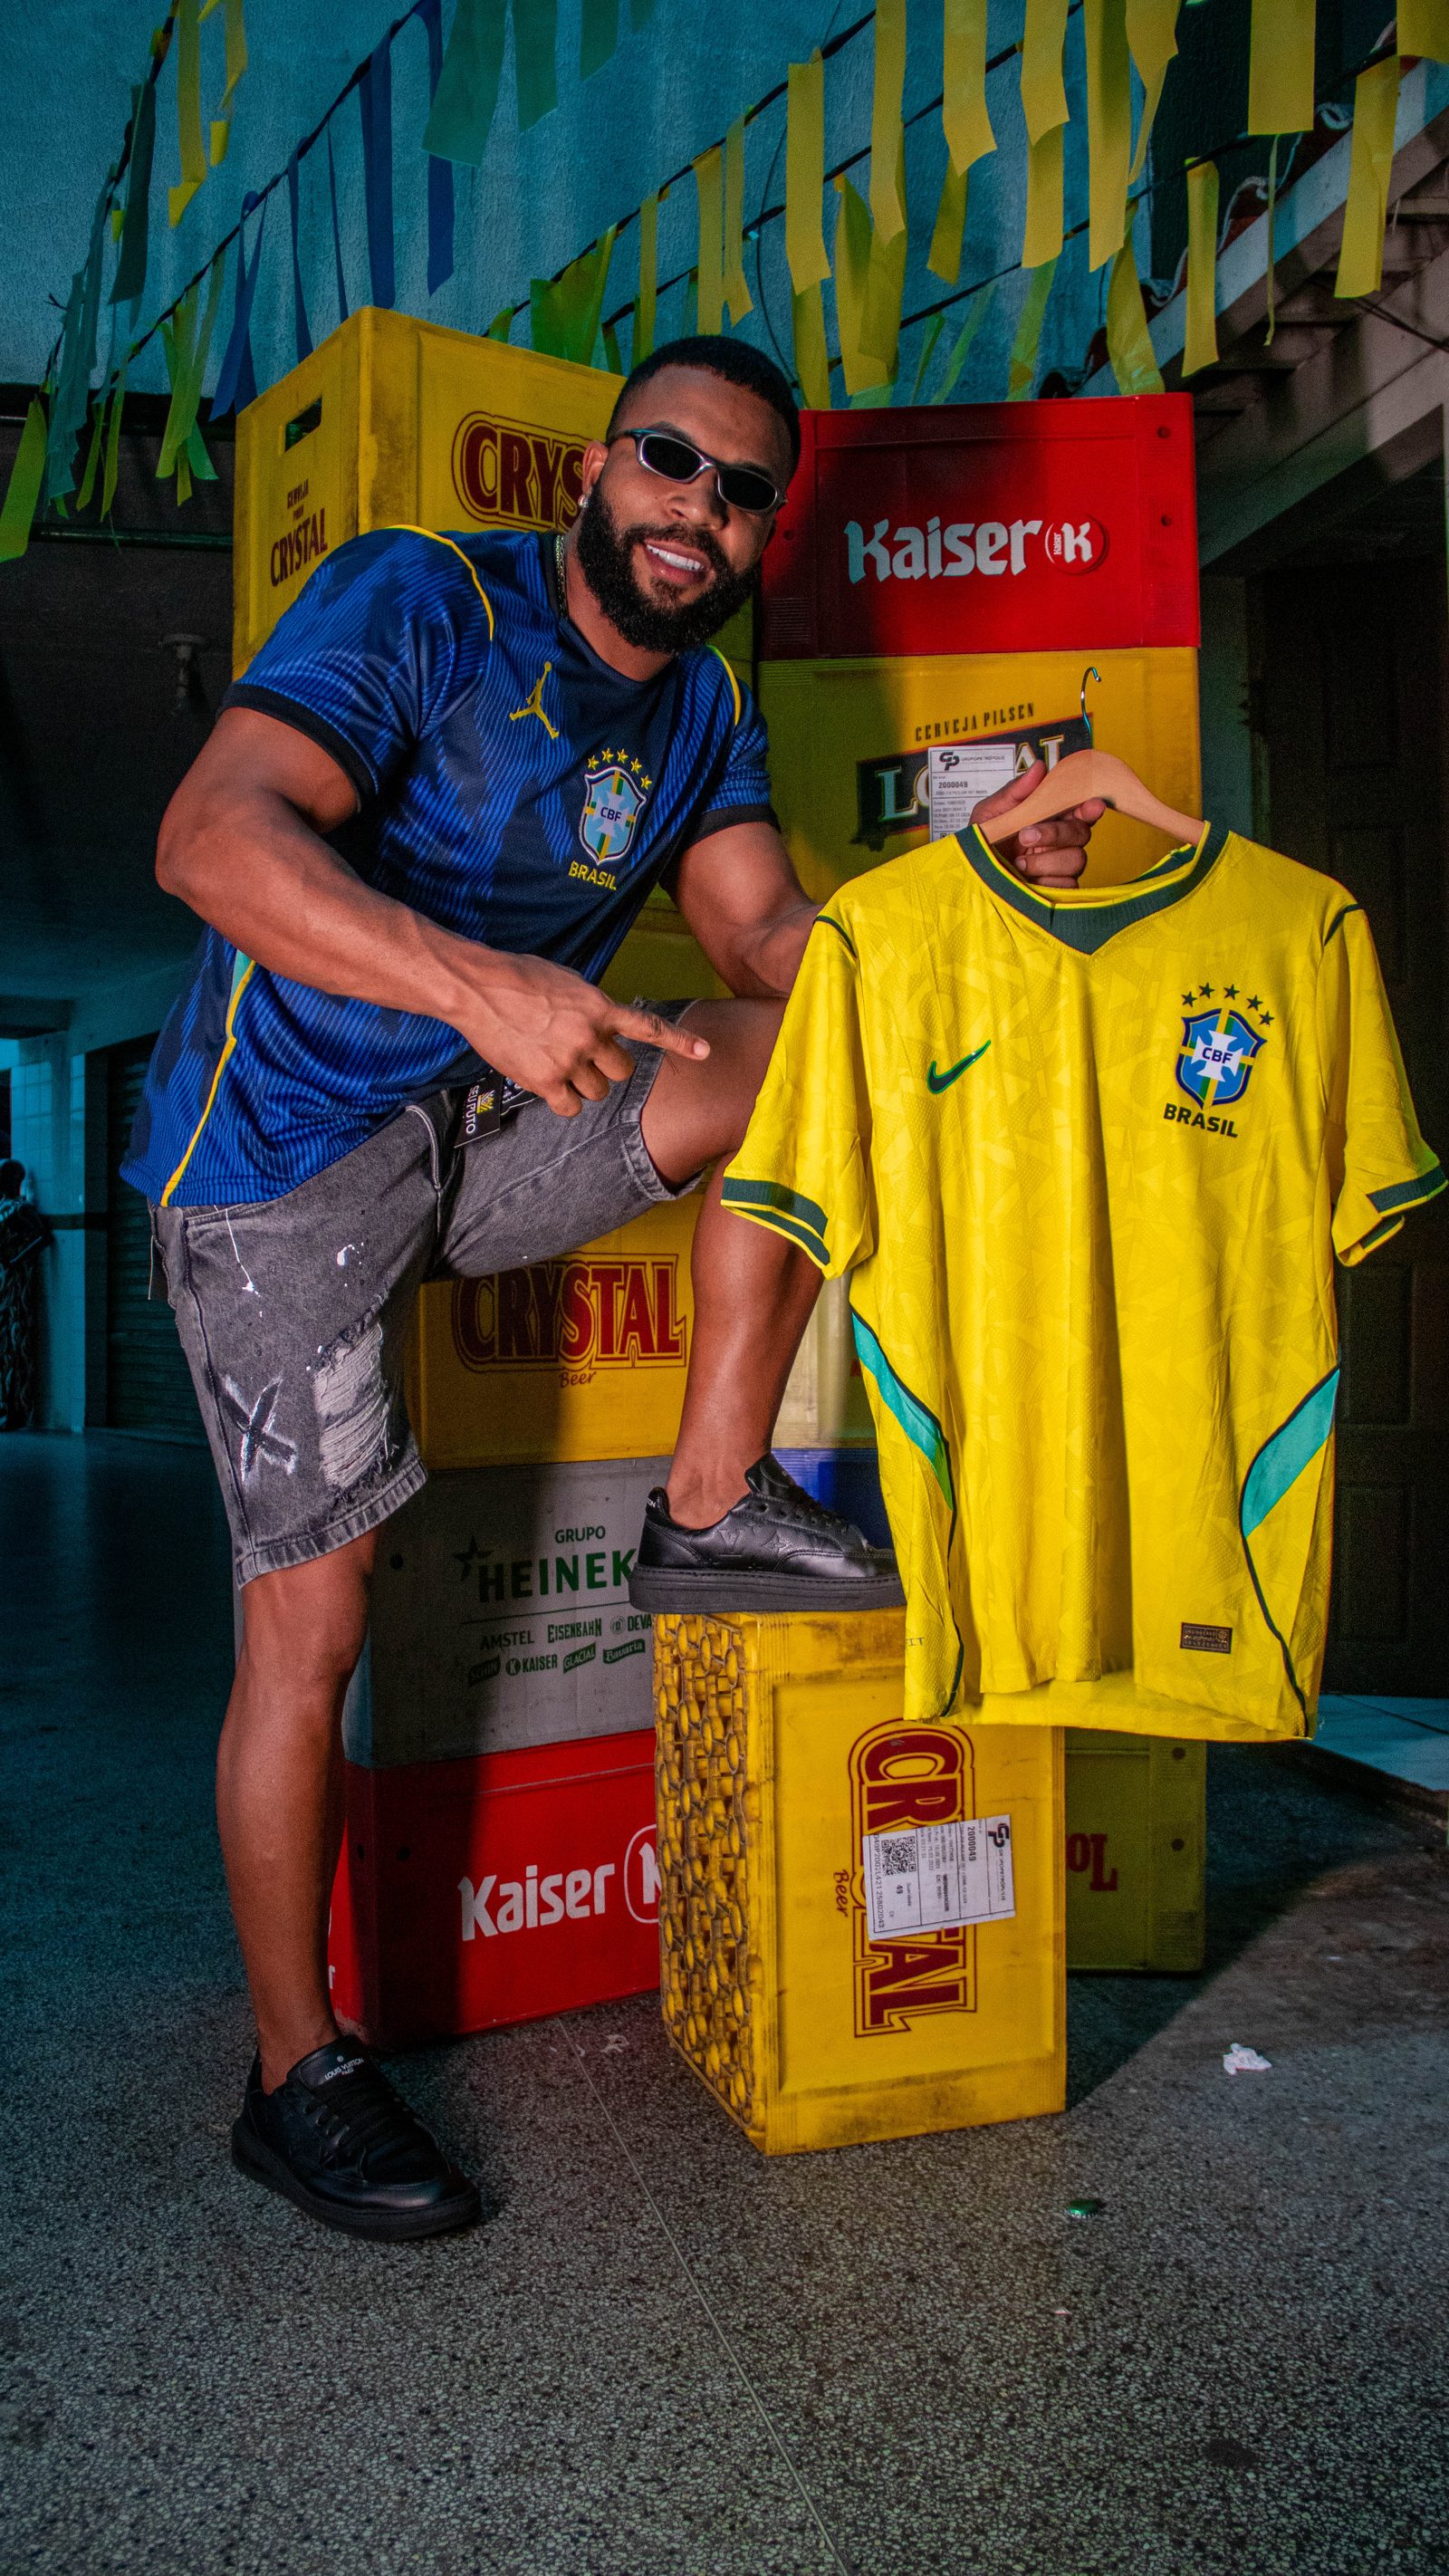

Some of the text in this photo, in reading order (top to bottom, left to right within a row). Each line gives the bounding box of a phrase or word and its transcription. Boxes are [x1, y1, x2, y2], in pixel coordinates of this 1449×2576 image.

[270, 507, 329, 587] CRYSTAL
[844, 515, 1042, 584] Kaiser
[1060, 522, 1093, 563] K
[915, 702, 1034, 742] CERVEJA PILSEN
[938, 781, 968, 789] 2000049
[600, 805, 622, 822] CBF
[568, 860, 617, 891] BRASIL
[1201, 1046, 1233, 1064] CBF
[465, 1084, 480, 1134] SEU PUTO
[1162, 1101, 1239, 1139] BRASIL
[456, 1261, 684, 1361] CRYSTAL
[558, 1370, 597, 1389] Beer
[554, 1525, 606, 1544] GRUPO
[480, 1629, 535, 1651] AMSTEL
[523, 1654, 558, 1673] KAISER
[565, 1648, 596, 1669] GLACIAL
[967, 1826, 977, 1862] 2000049
[456, 1862, 616, 1942] Kaiser
[832, 1869, 849, 1918] Beer
[896, 1884, 904, 1895] 49
